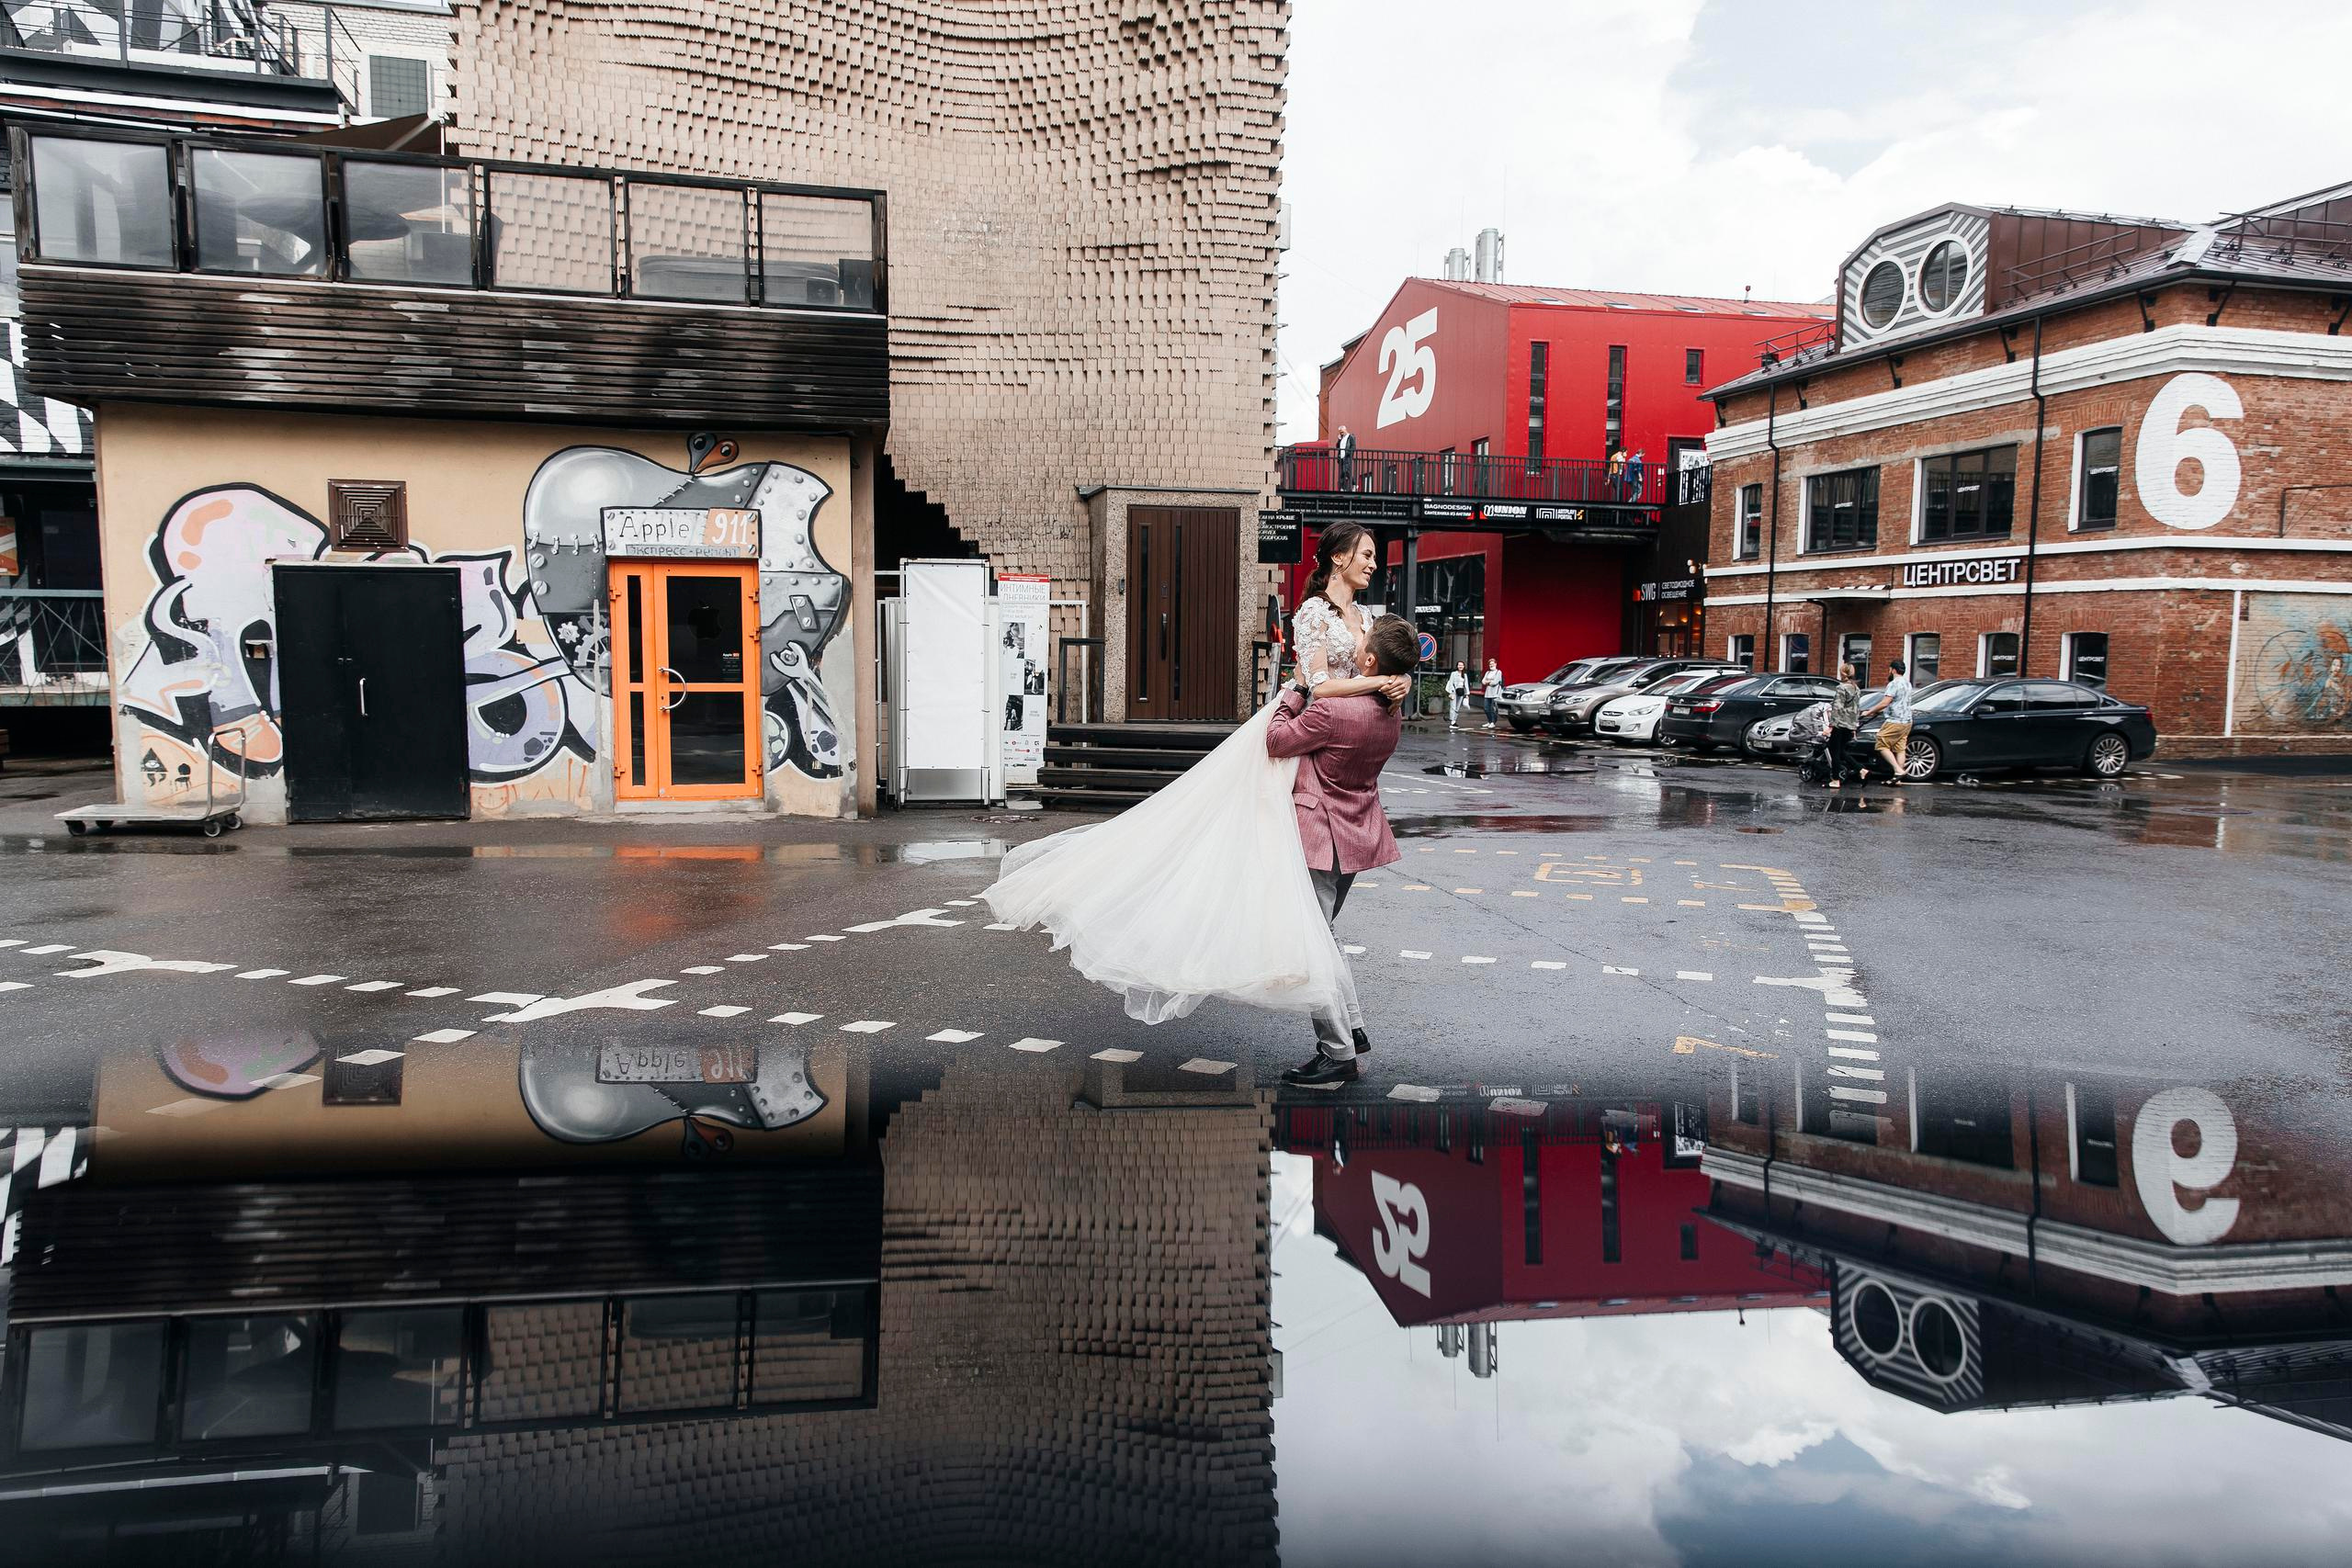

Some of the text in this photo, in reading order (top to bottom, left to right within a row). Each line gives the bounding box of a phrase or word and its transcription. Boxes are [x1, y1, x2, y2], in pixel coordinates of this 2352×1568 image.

[1376, 307, 1439, 430] 25
[2136, 372, 2244, 530] 6
[1494, 506, 1528, 514] UNION
[619, 512, 749, 546] Apple 911
[1903, 558, 2020, 588] ЦЕНТРСВЕТ
[1000, 583, 1046, 594] ИНТИМНЫЕ
[1641, 582, 1657, 601] SWG
[1661, 580, 1695, 590] СВЕТОДИОДНОЕ
[1661, 590, 1688, 599] ОСВЕЩЕНИЕ
